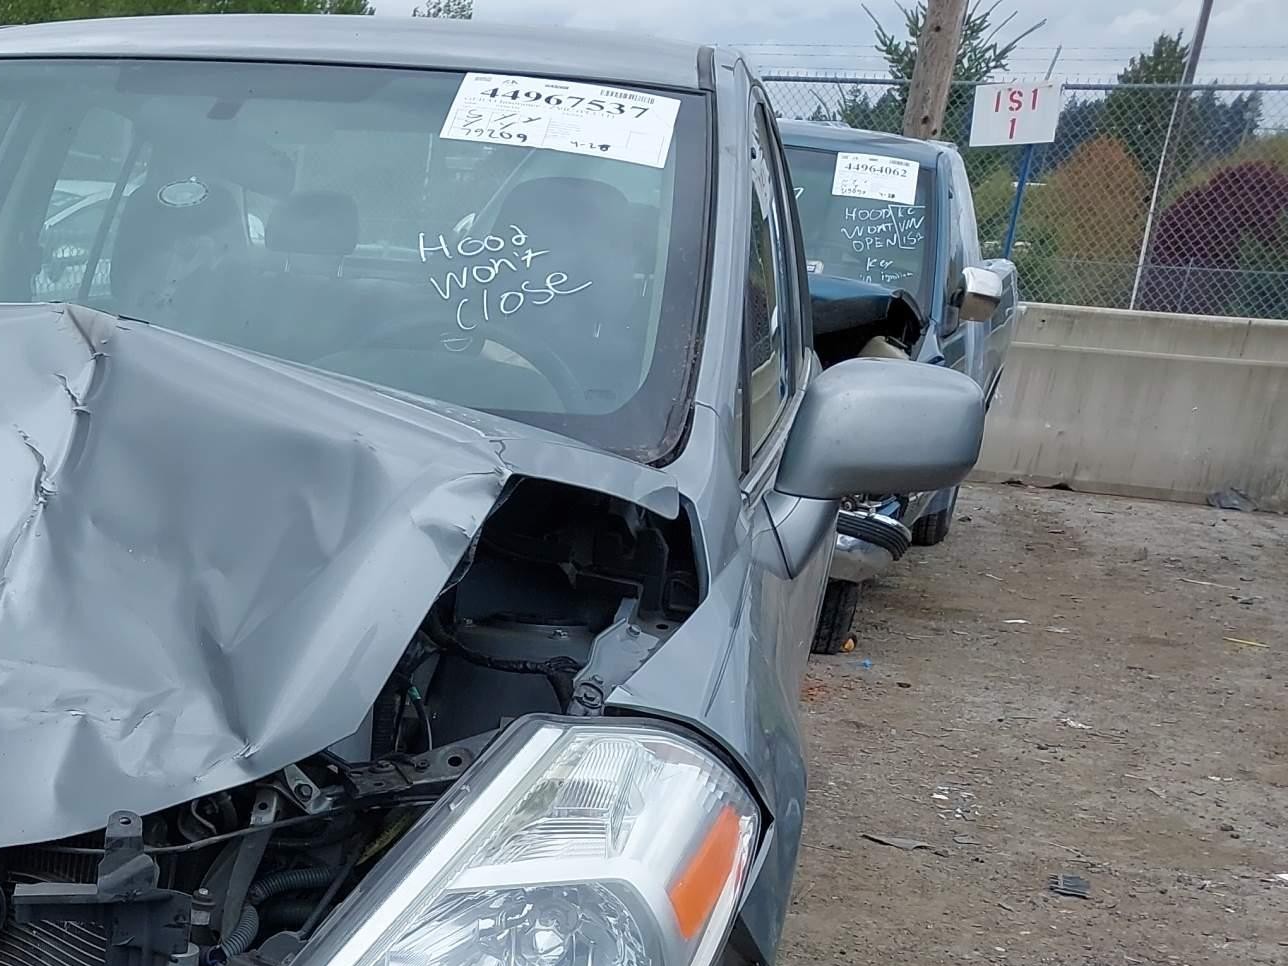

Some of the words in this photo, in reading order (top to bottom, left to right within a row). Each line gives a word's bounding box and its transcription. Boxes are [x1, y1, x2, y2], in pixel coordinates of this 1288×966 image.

[480, 87, 650, 118] 44967537
[844, 163, 908, 178] 44964062
[845, 207, 892, 220] HOOD
[899, 216, 925, 232] VIN
[852, 233, 897, 252] OPEN
